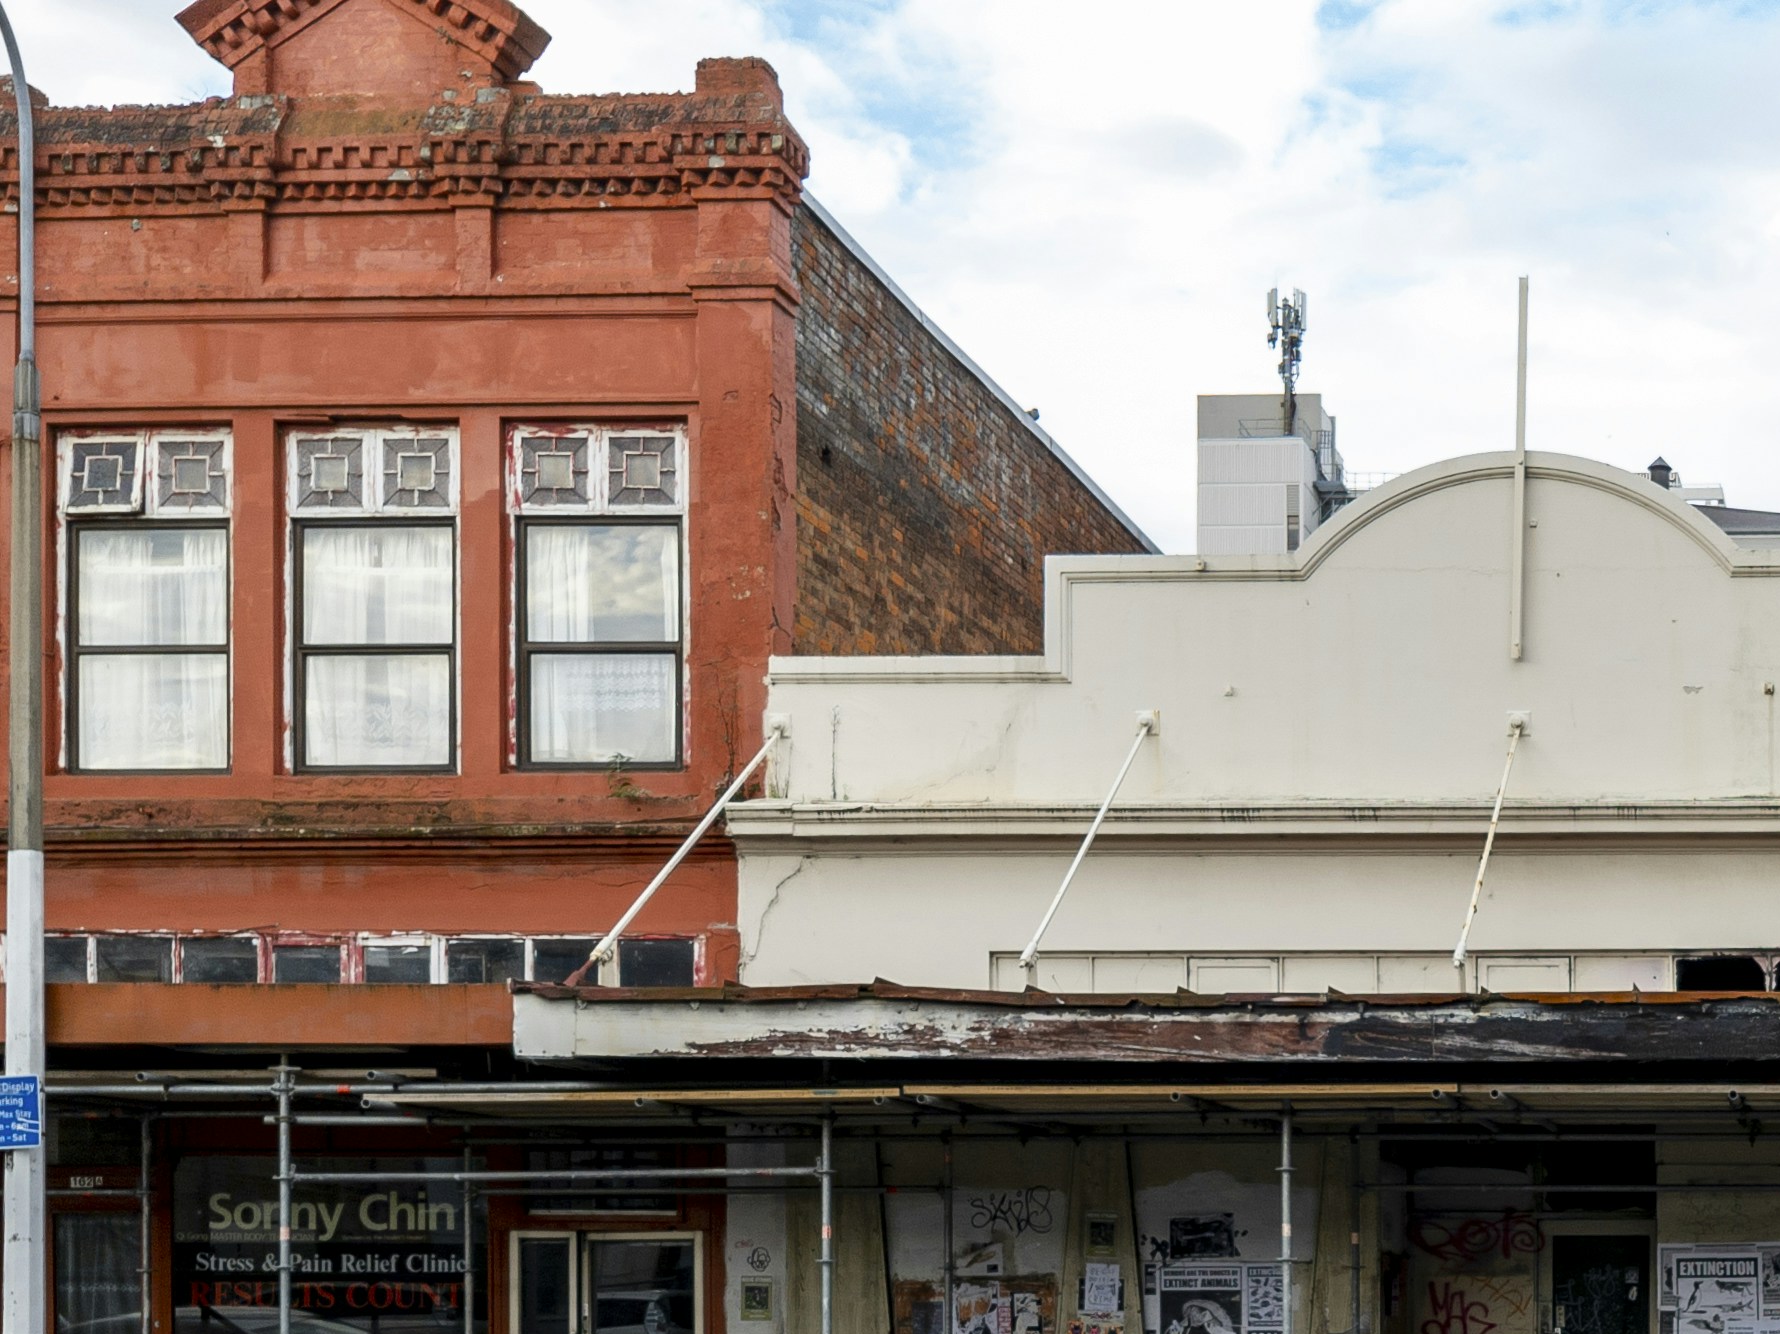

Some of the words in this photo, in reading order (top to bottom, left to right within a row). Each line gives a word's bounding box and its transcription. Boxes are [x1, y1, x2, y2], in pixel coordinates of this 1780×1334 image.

[2, 1082, 35, 1095] Display
[12, 1133, 27, 1142] Sat
[359, 1191, 455, 1231] Chin
[195, 1252, 254, 1272] Stress
[288, 1253, 333, 1272] Pain
[341, 1253, 400, 1273] Relief
[405, 1253, 468, 1273] Clinic
[1679, 1260, 1756, 1277] EXTINCTION
[1163, 1279, 1199, 1288] EXTINCT
[1201, 1279, 1239, 1288] ANIMALS
[190, 1281, 336, 1308] RESUTS
[346, 1281, 466, 1309] COUNT
